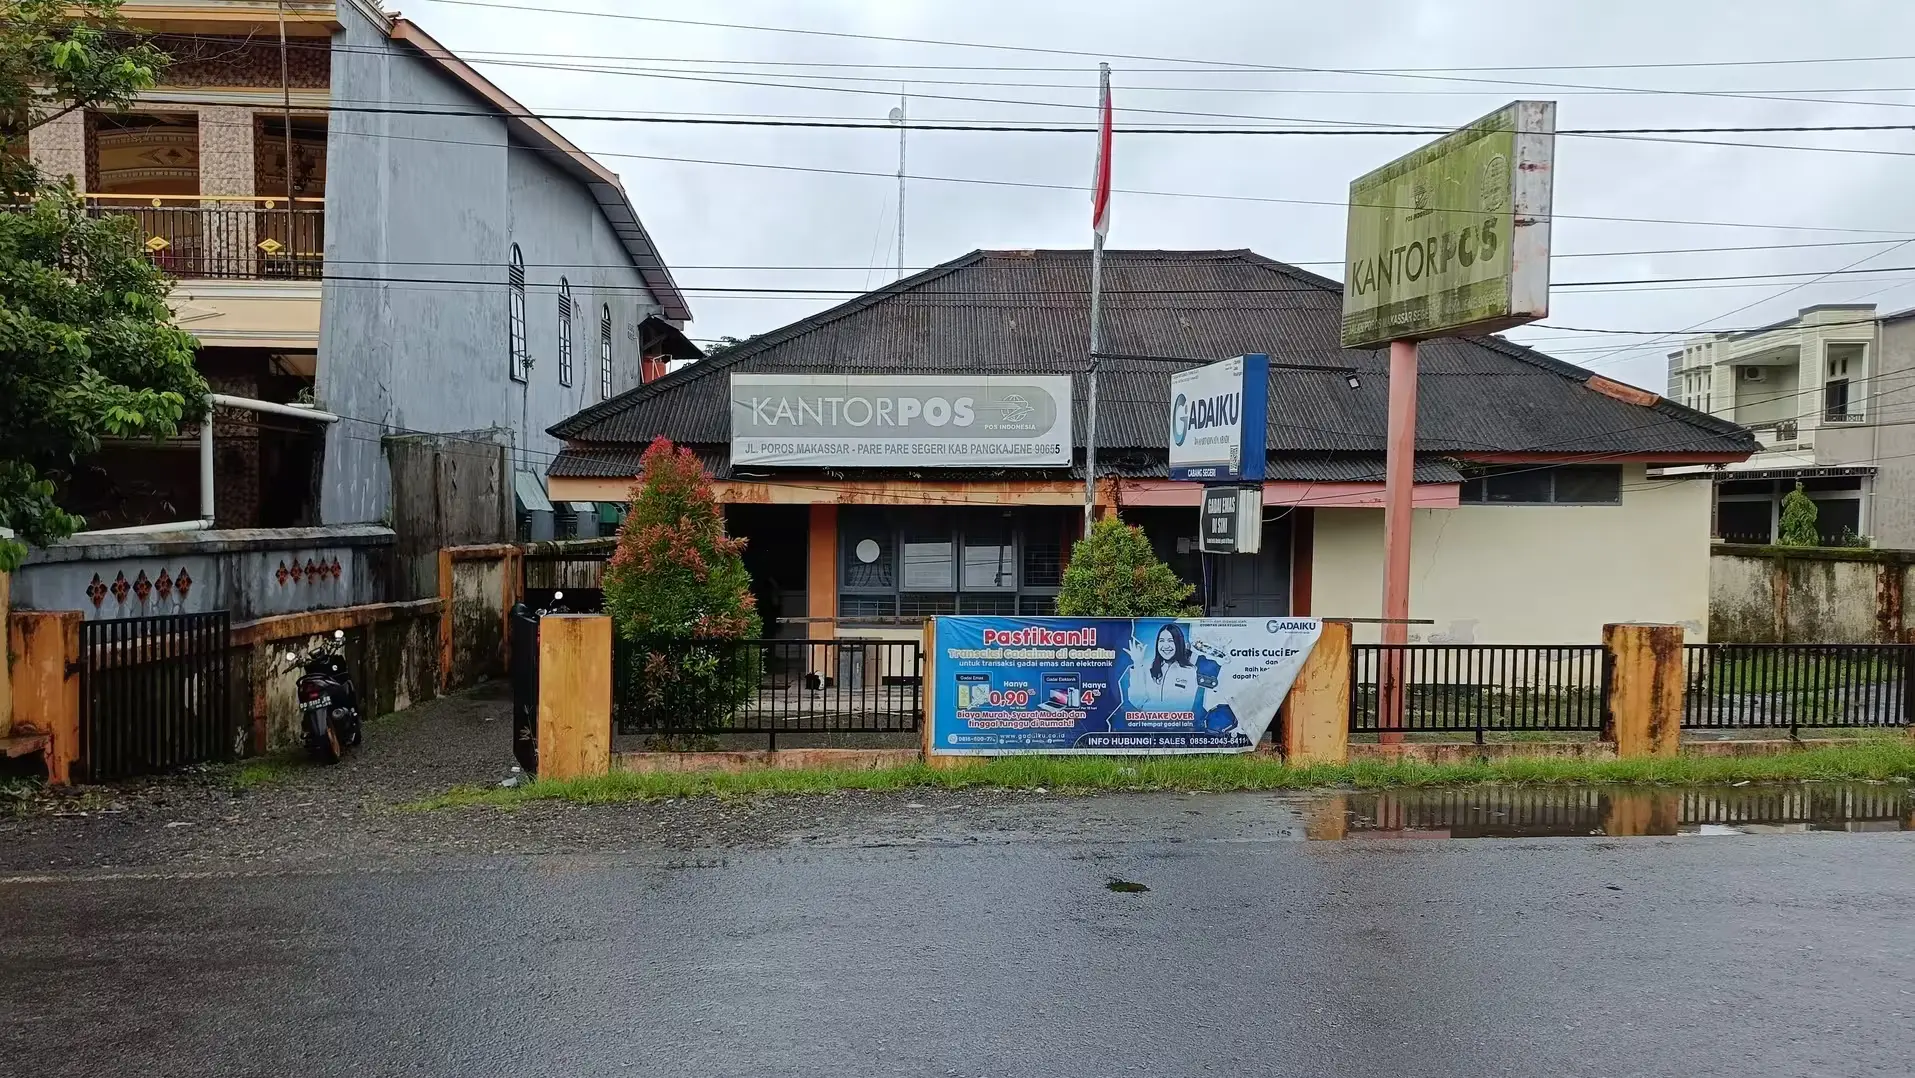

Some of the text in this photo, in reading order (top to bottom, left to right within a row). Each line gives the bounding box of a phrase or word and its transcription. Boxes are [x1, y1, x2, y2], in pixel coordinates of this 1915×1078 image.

[752, 397, 975, 427] KANTORPOS
[745, 443, 758, 454] JL.
[761, 443, 794, 454] POROS
[797, 443, 850, 454] MAKASSAR
[857, 443, 882, 454] PARE
[884, 443, 909, 454] PARE
[911, 443, 947, 454] SEGERI
[949, 443, 968, 454] KAB
[970, 443, 1033, 454] PANGKAJENE
[1034, 443, 1061, 454] 90655
[1266, 620, 1316, 634] GADAIKU
[984, 626, 1096, 646] Pastikan!!
[948, 648, 1115, 659] Transaksi Gadaimu di Gadaiku
[1230, 648, 1260, 657] Gratis
[1262, 648, 1283, 657] Cuci
[1017, 660, 1038, 668] gadai
[1003, 681, 1028, 689] Hanya
[1082, 682, 1107, 690] Hanya
[956, 710, 981, 719] Biaya
[1011, 710, 1039, 720] Syarat
[1039, 710, 1068, 719] Mudah
[1068, 710, 1087, 719] dan
[1126, 712, 1194, 720] BISA TAKE OVER
[968, 719, 1075, 729] tinggal tunggu di Rumah!!
[1088, 737, 1110, 745] INFO
[1111, 737, 1152, 745] HUBUNGI
[1158, 737, 1186, 745] SALES
